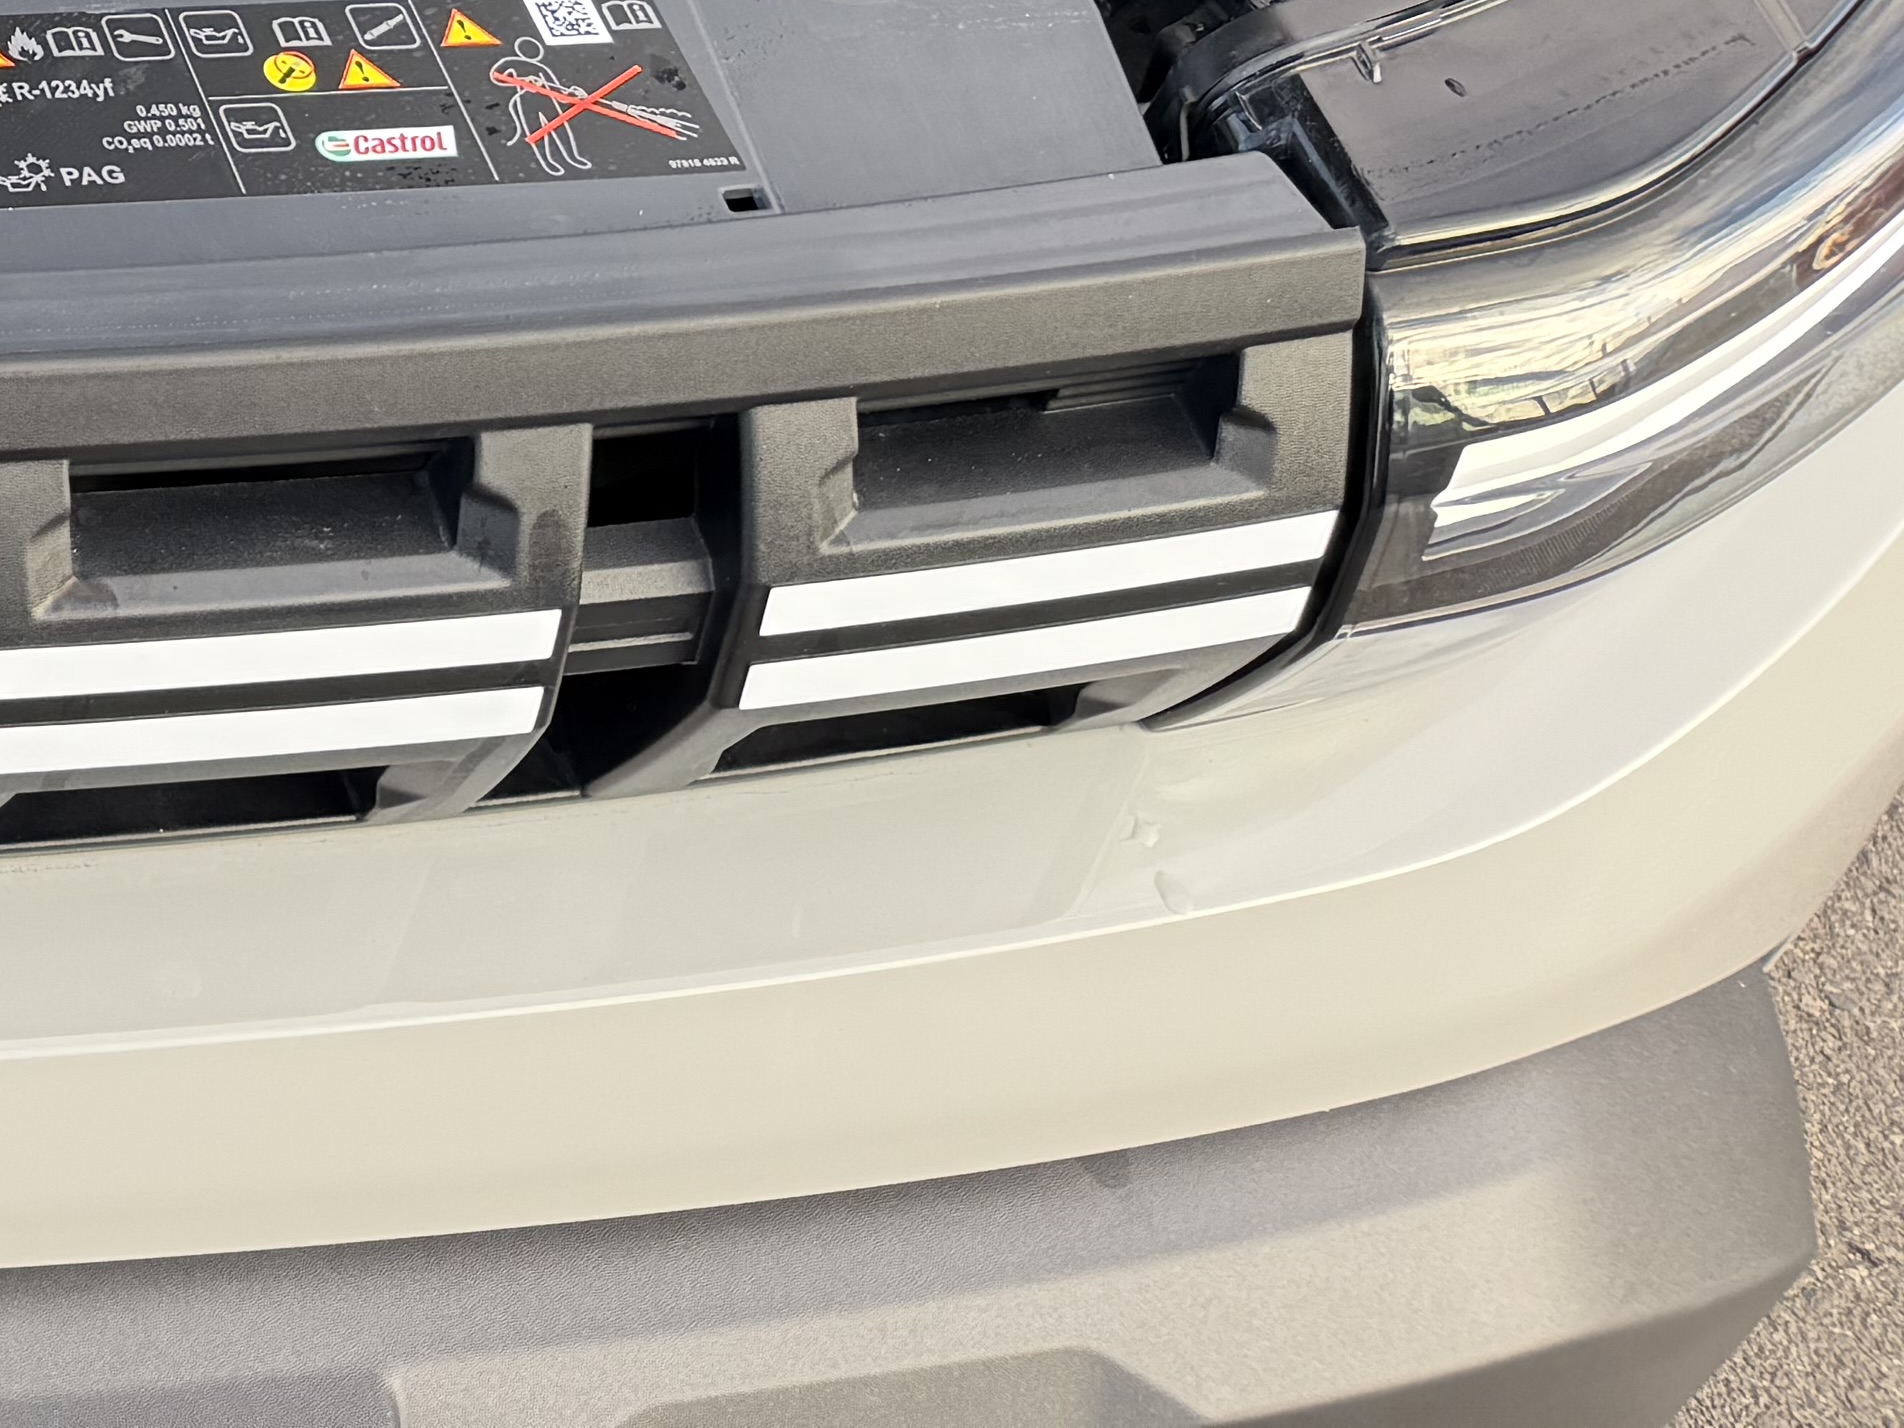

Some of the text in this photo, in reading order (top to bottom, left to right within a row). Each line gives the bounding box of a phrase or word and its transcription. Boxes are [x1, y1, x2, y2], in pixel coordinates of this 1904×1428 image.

[12, 78, 115, 101] R-1234yf
[136, 103, 201, 117] 0.450 kg
[124, 118, 206, 133] GWP 0.501
[154, 133, 203, 148] 0.0002
[354, 131, 447, 155] Castrol
[60, 165, 125, 187] PAG
